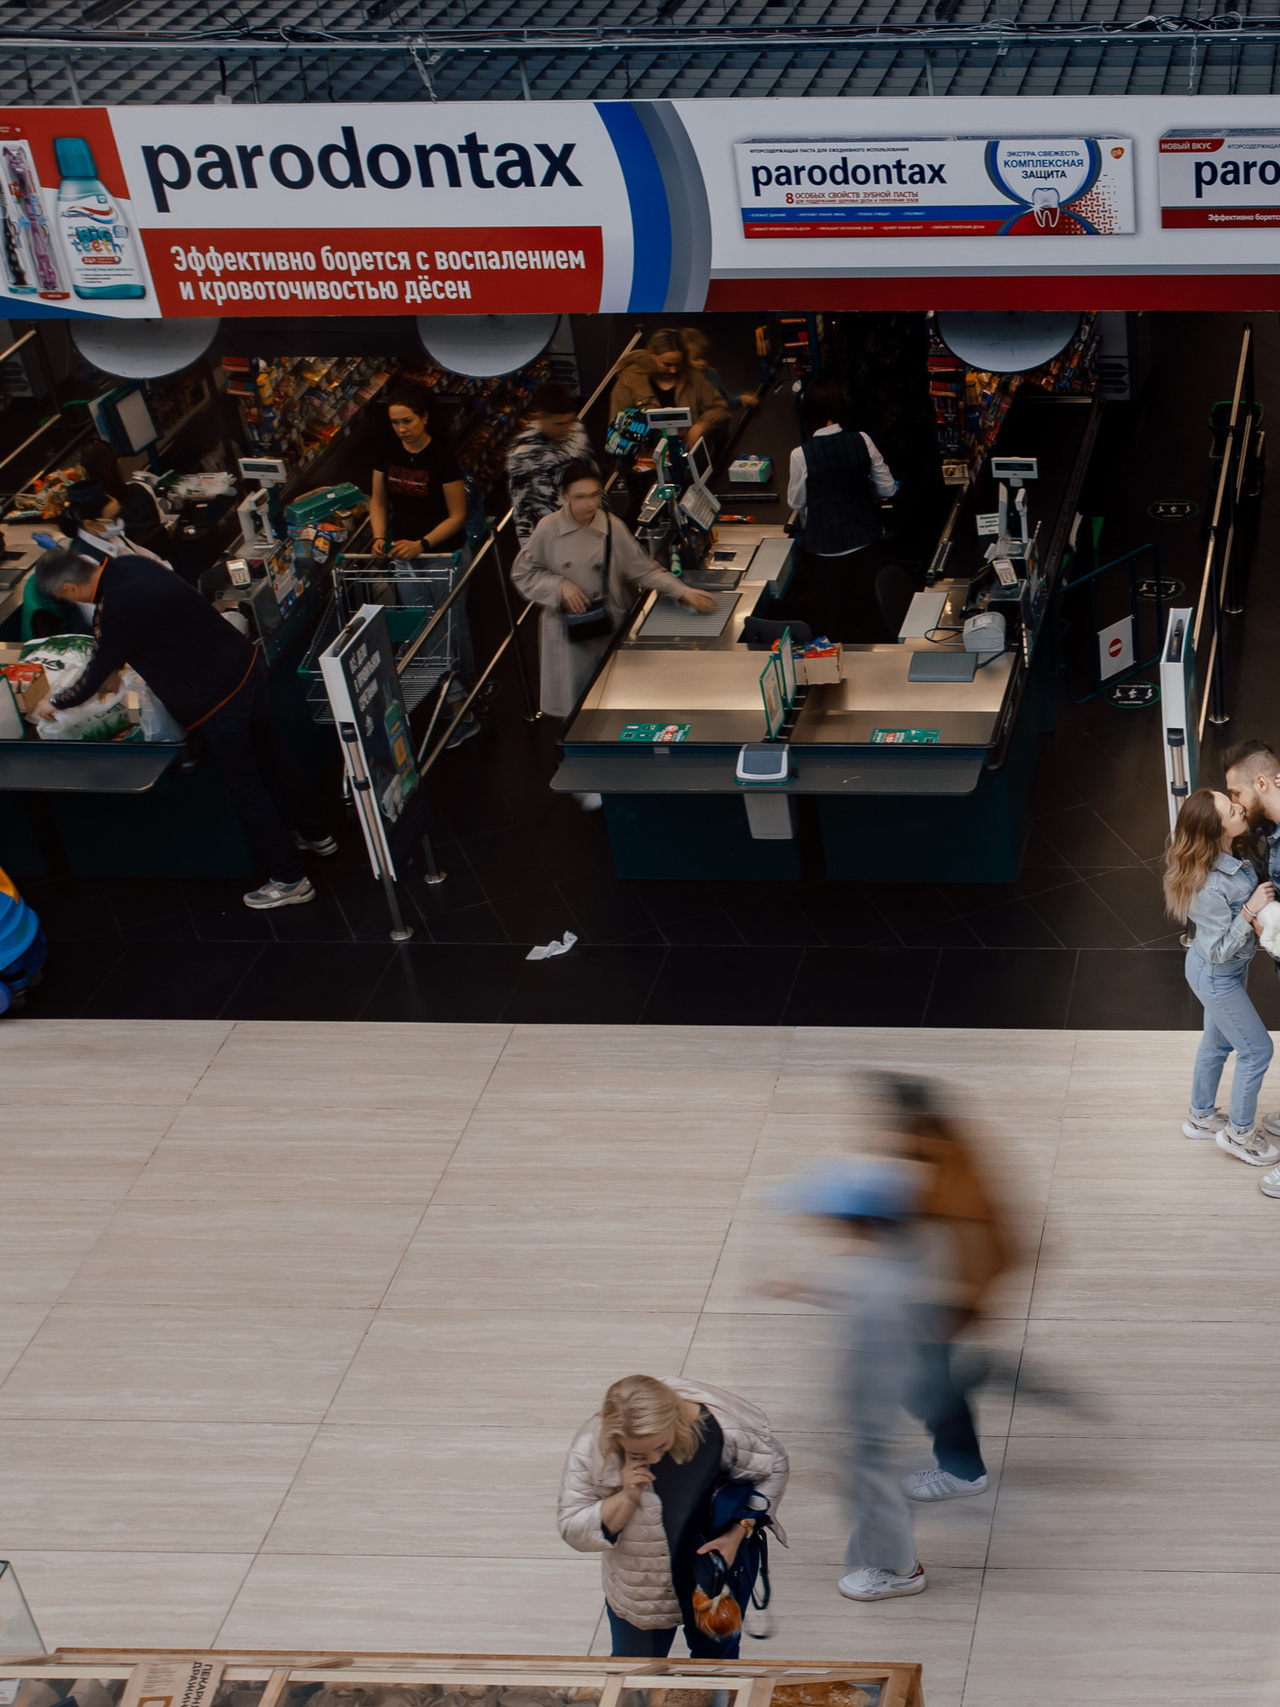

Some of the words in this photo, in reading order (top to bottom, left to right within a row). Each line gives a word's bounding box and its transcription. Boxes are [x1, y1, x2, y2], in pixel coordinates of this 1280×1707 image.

[1161, 142, 1191, 150] НОВЫЙ
[1192, 142, 1212, 150] ВКУС
[141, 126, 584, 213] parodontax
[1003, 158, 1084, 168] КОМПЛЕКСНАЯ
[752, 156, 947, 197] parodontax
[1021, 169, 1067, 181] ЗАЩИТА
[785, 192, 795, 205] 8
[828, 190, 860, 199] СВОЙСТВ
[862, 190, 891, 198] ЗУБНОЙ
[1208, 213, 1254, 221] Эффективно
[71, 238, 123, 254] teeth
[170, 245, 316, 275] Эффективно
[320, 246, 411, 273] борется
[415, 251, 430, 271] с
[434, 247, 587, 271] воспалением
[179, 282, 194, 301] и
[199, 276, 399, 305] кровоточивостью
[404, 276, 473, 305] дёсен
